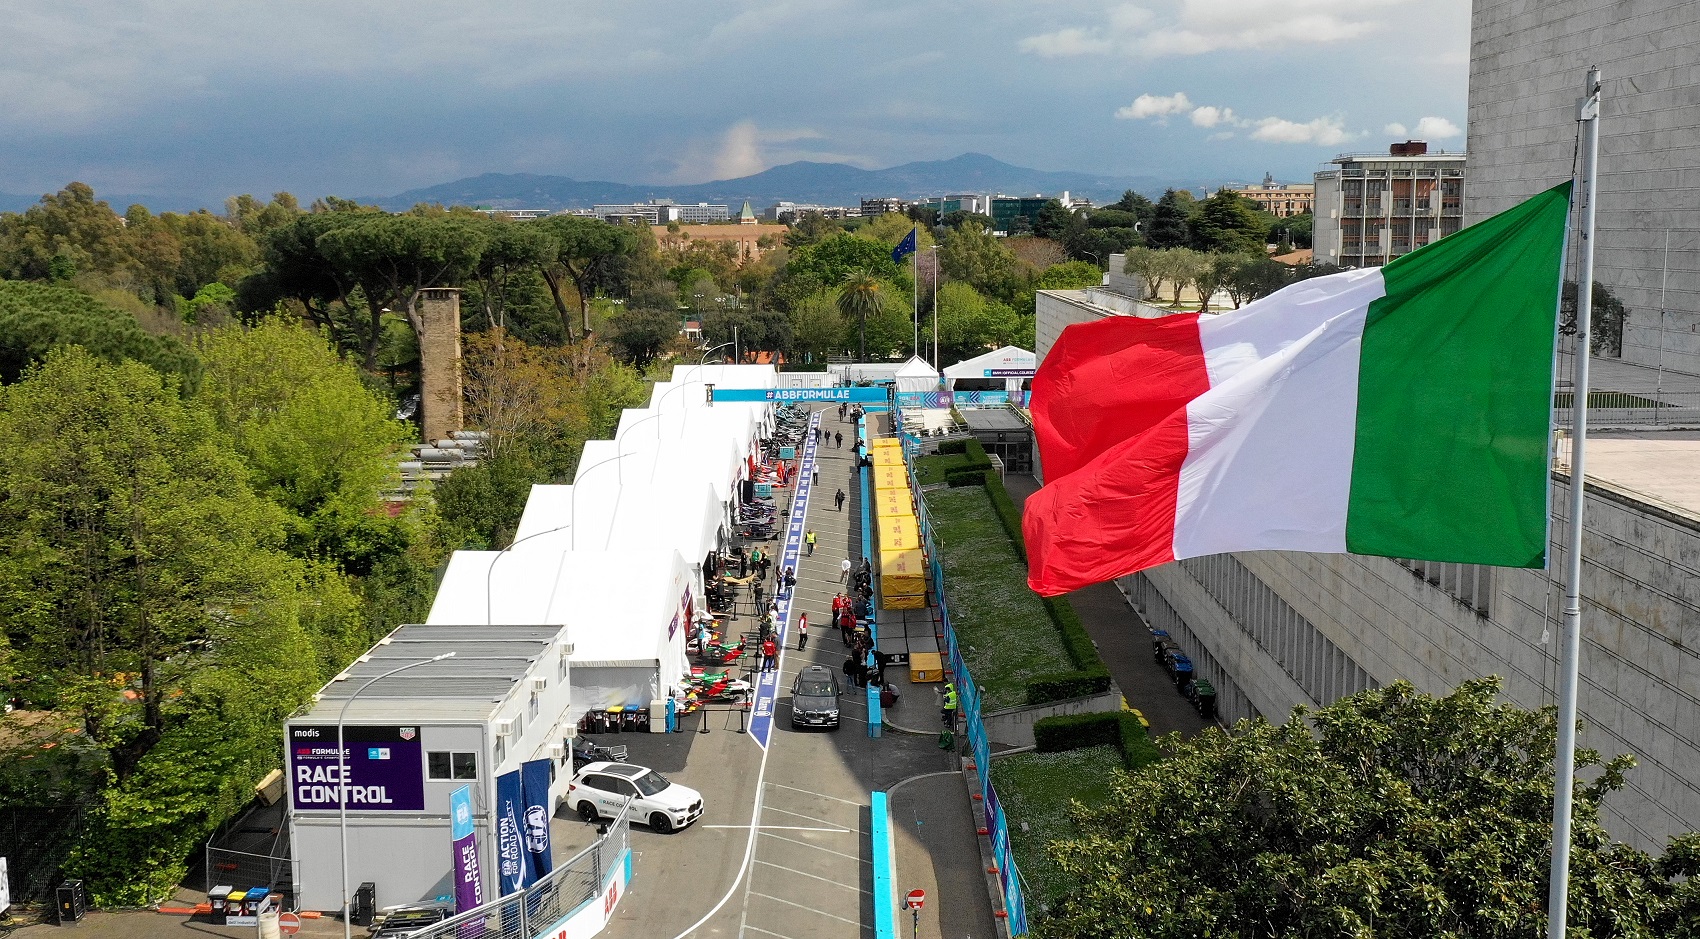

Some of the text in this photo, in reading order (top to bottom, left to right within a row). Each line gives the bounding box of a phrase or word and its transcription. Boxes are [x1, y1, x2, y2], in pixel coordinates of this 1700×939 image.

[294, 728, 320, 738] modis
[297, 765, 352, 783] RACE
[298, 785, 393, 804] CONTROL
[602, 799, 616, 807] RACE
[500, 817, 511, 859] ACTION
[505, 799, 519, 874] FOR ROAD SAFETY
[524, 807, 547, 853] FIA
[462, 846, 473, 883] RACE
[469, 840, 482, 905] CONTROL
[603, 880, 618, 922] ABB
